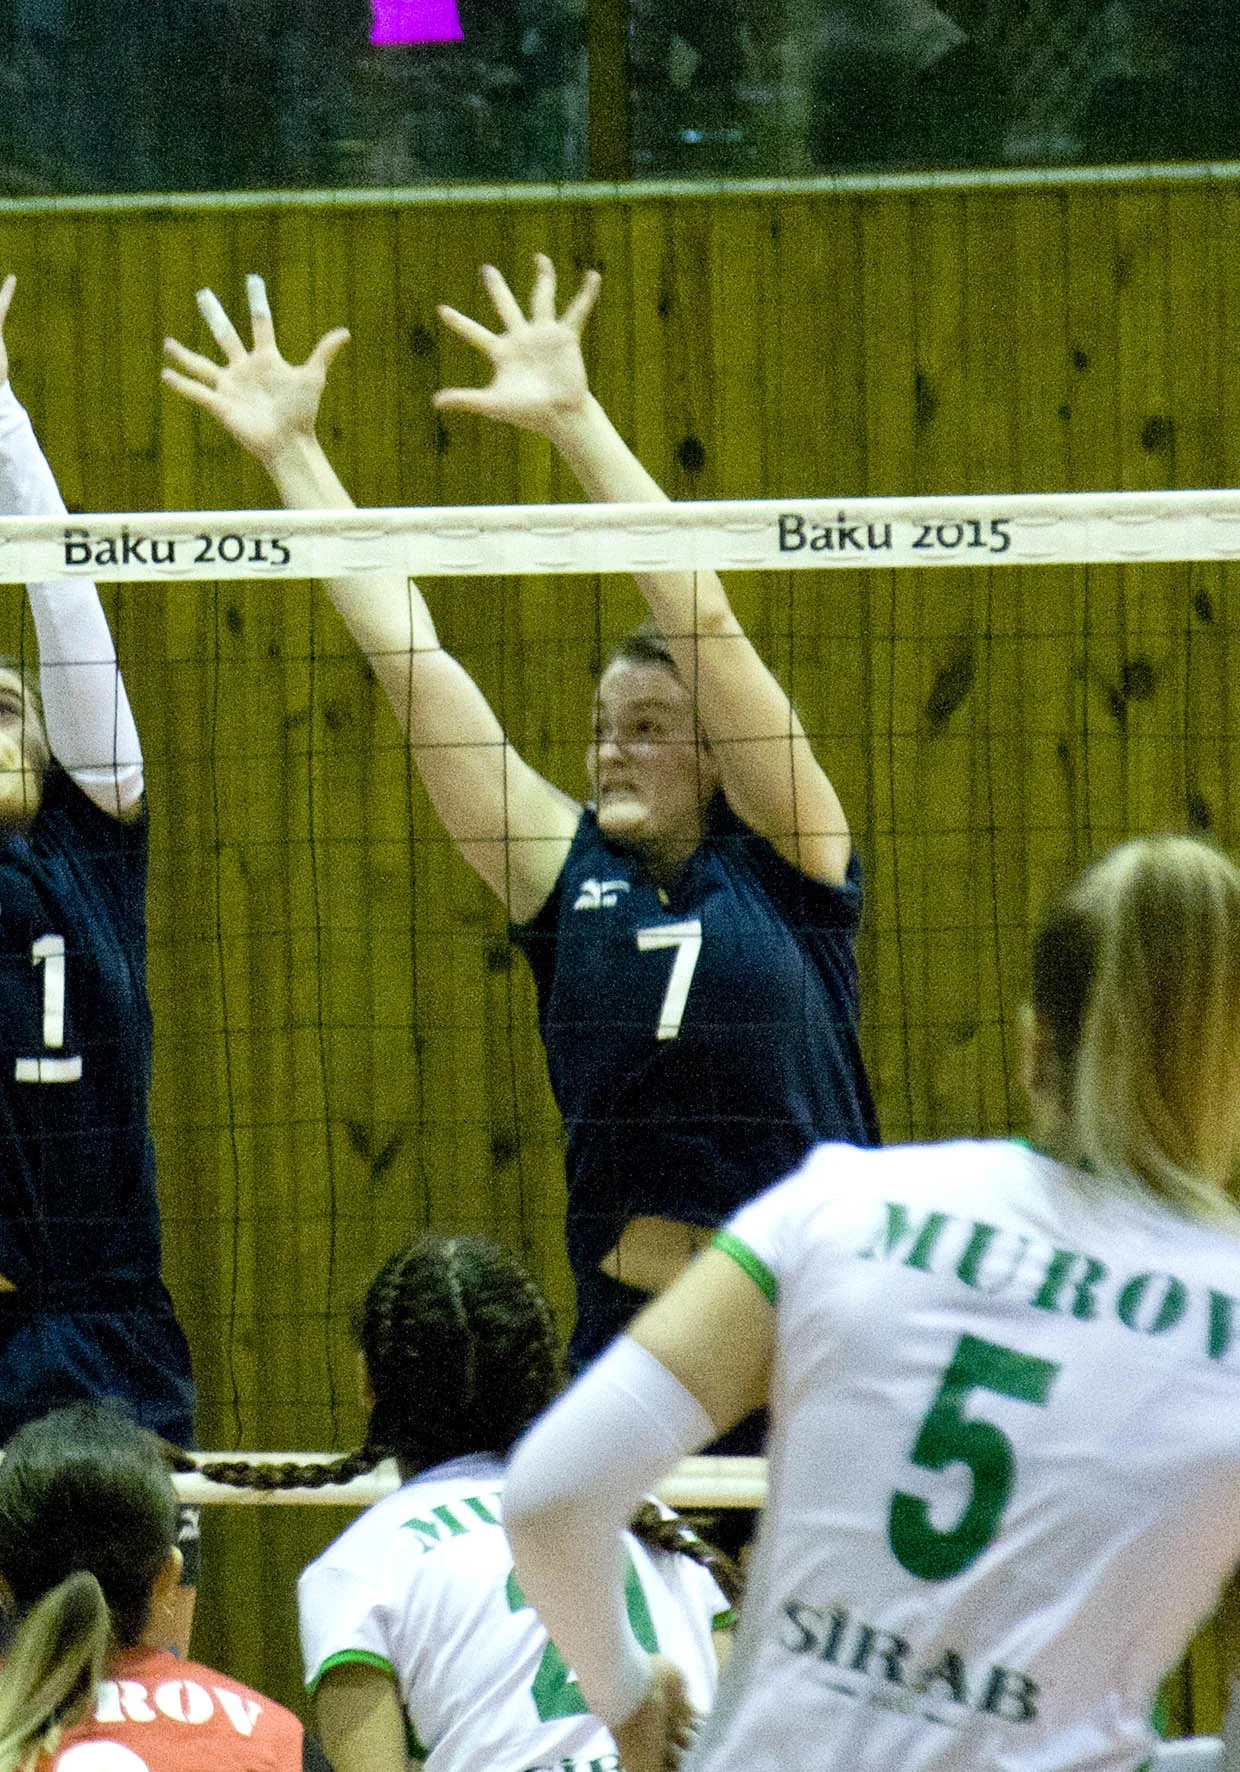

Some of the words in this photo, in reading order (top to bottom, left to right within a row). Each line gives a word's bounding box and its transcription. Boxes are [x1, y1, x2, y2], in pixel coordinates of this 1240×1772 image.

[64, 524, 177, 566] Baku
[194, 532, 292, 565] 2015
[778, 510, 893, 551] Baku
[912, 517, 1012, 553] 2015
[636, 919, 703, 1040] 7
[886, 1331, 1061, 1582] 5
[94, 1679, 262, 1737] ROV
